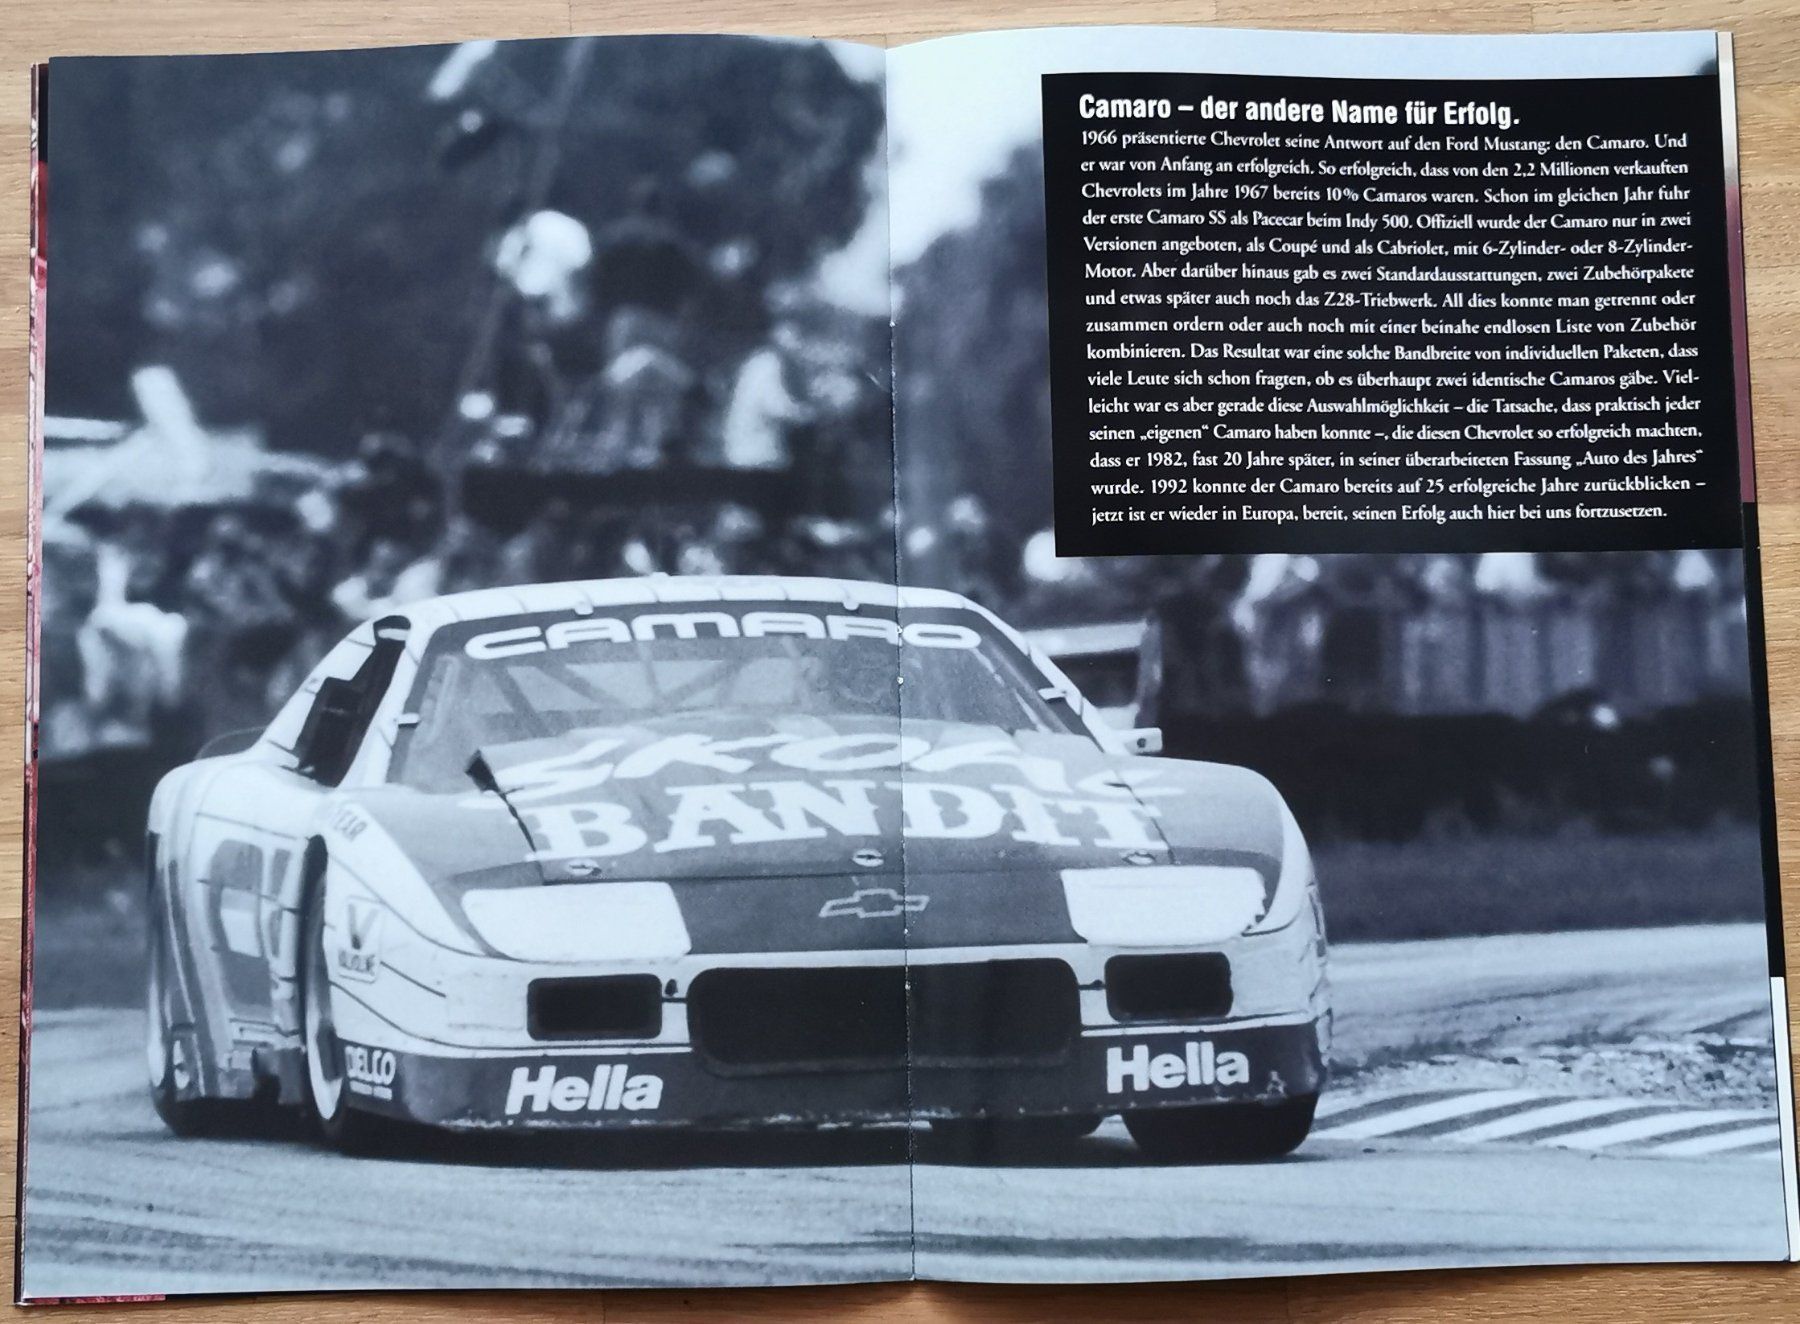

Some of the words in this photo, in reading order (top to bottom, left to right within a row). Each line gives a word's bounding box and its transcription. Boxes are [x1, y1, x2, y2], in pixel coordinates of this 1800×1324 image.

[1079, 94, 1171, 119] Camaro
[1200, 95, 1238, 119] der
[1245, 98, 1324, 123] andere
[1332, 99, 1398, 124] Name
[1405, 101, 1437, 125] für
[1444, 101, 1519, 130] Erfolg.
[1082, 130, 1117, 145] 1966
[1122, 130, 1206, 149] präsentierte
[1210, 130, 1280, 147] Chevrolet
[1285, 134, 1320, 148] seine
[1324, 135, 1383, 150] Antwort
[1388, 135, 1412, 150] auf
[1414, 135, 1440, 150] den
[1446, 136, 1479, 151] Ford
[1484, 136, 1550, 155] Mustang:
[1555, 135, 1582, 150] den
[1587, 135, 1649, 149] Camaro.
[1655, 133, 1687, 148] Und
[1082, 182, 1162, 198] Chevrolets
[1167, 183, 1186, 197] im
[1190, 182, 1228, 201] Jahre
[1235, 184, 1269, 199] 1967
[1273, 184, 1320, 201] bereits
[1326, 187, 1359, 201] 10%
[1363, 187, 1427, 202] Camaros
[1431, 193, 1479, 203] waren.
[1484, 188, 1528, 203] Schon
[1534, 188, 1553, 202] im
[1558, 187, 1618, 207] gleichen
[1623, 186, 1654, 204] Jahr
[1658, 185, 1690, 200] fuhr
[1083, 236, 1157, 251] Versionen
[1162, 235, 1242, 256] angeboten,
[1246, 236, 1265, 252] als
[1269, 238, 1318, 257] Coupé
[1322, 239, 1350, 254] und
[1354, 239, 1373, 254] als
[1377, 239, 1449, 256] Cabriolet,
[1454, 241, 1478, 255] mit
[1482, 240, 1566, 259] 6-Zylinder-
[1570, 239, 1604, 254] oder
[1608, 238, 1693, 257] 8-Zylinder-
[1085, 263, 1136, 278] Motor.
[1141, 262, 1177, 278] Aber
[1181, 262, 1238, 278] darüber
[1242, 263, 1289, 279] hinaus
[1293, 264, 1319, 284] gab
[1323, 270, 1337, 280] es
[1341, 266, 1372, 280] zwei
[1377, 266, 1542, 286] Standardausstattungen,
[1547, 266, 1578, 281] zwei
[1583, 264, 1694, 283] Zubehörpakete
[1086, 289, 1116, 305] und
[1120, 294, 1162, 304] etwas
[1166, 291, 1211, 309] später
[1215, 289, 1250, 305] auch
[1255, 290, 1291, 306] noch
[1295, 290, 1320, 306] das
[1324, 291, 1437, 307] Z28-Triebwerk.
[1442, 293, 1463, 307] All
[1468, 292, 1497, 307] dies
[1501, 292, 1553, 307] konnte
[1558, 297, 1590, 307] man
[1594, 295, 1657, 311] getrennt
[1661, 290, 1696, 305] oder
[1086, 321, 1168, 332] zusammen
[1173, 315, 1224, 331] ordern
[1229, 316, 1263, 332] oder
[1267, 317, 1303, 332] auch
[1308, 317, 1344, 333] noch
[1350, 319, 1375, 333] mit
[1380, 319, 1418, 334] einer
[1421, 318, 1480, 334] beinahe
[1484, 318, 1550, 334] endlosen
[1556, 319, 1592, 333] Liste
[1597, 322, 1625, 332] von
[1630, 316, 1697, 332] Zubehör
[1087, 342, 1185, 359] kombinieren.
[1191, 343, 1219, 358] Das
[1223, 343, 1280, 359] Resultat
[1284, 349, 1310, 359] war
[1313, 344, 1343, 359] eine
[1347, 344, 1391, 360] solche
[1394, 345, 1471, 360] Bandbreite
[1474, 350, 1501, 360] von
[1506, 344, 1599, 360] individuellen
[1604, 344, 1664, 359] Paketen,
[1668, 343, 1698, 357] dass
[1088, 370, 1122, 386] viele
[1127, 370, 1169, 385] Leute
[1174, 369, 1203, 385] sich
[1208, 369, 1250, 385] schon
[1255, 369, 1311, 390] fragten,
[1315, 370, 1335, 386] ob
[1338, 376, 1353, 386] es
[1357, 371, 1431, 391] überhaupt
[1436, 372, 1467, 387] zwei
[1472, 371, 1546, 386] identische
[1549, 371, 1615, 386] Camaros
[1619, 370, 1658, 390] gäbe.
[1662, 368, 1699, 384] Viel-
[1089, 397, 1129, 413] leicht
[1133, 402, 1161, 412] war
[1164, 402, 1179, 412] es
[1183, 396, 1214, 412] aber
[1218, 396, 1264, 417] gerade
[1268, 396, 1303, 412] diese
[1307, 397, 1449, 418] Auswahlmöglichkeit
[1466, 398, 1489, 413] die
[1492, 397, 1558, 413] Tatsache,
[1561, 397, 1591, 412] dass
[1595, 396, 1661, 416] praktisch
[1666, 395, 1701, 413] jeder
[1090, 452, 1121, 468] dass
[1126, 457, 1141, 467] er
[1147, 452, 1187, 467] 1982,
[1193, 450, 1218, 466] fast
[1223, 451, 1242, 466] 20
[1246, 450, 1284, 469] Jahre
[1288, 453, 1335, 471] später,
[1340, 452, 1354, 466] in
[1359, 452, 1401, 466] seiner
[1405, 451, 1509, 466] überarbeiteten
[1514, 451, 1572, 470] Fassung
[1623, 449, 1648, 464] des
[1092, 507, 1124, 526] jetzt
[1129, 507, 1145, 521] ist
[1150, 511, 1165, 521] er
[1169, 505, 1218, 520] wieder
[1223, 506, 1237, 520] in
[1242, 505, 1298, 525] Europa,
[1303, 504, 1348, 521] bereit,
[1352, 505, 1397, 520] seinen
[1402, 504, 1447, 525] Erfolg
[1449, 504, 1483, 520] auch
[1487, 504, 1516, 519] hier
[1519, 504, 1541, 519] bei
[1546, 509, 1572, 519] uns
[1576, 503, 1667, 518] fortzusetzen.
[465, 610, 982, 660] CAMARO
[524, 779, 1162, 861] BANDIT
[1106, 1041, 1250, 1094] Hella
[505, 1063, 664, 1116] Hella
